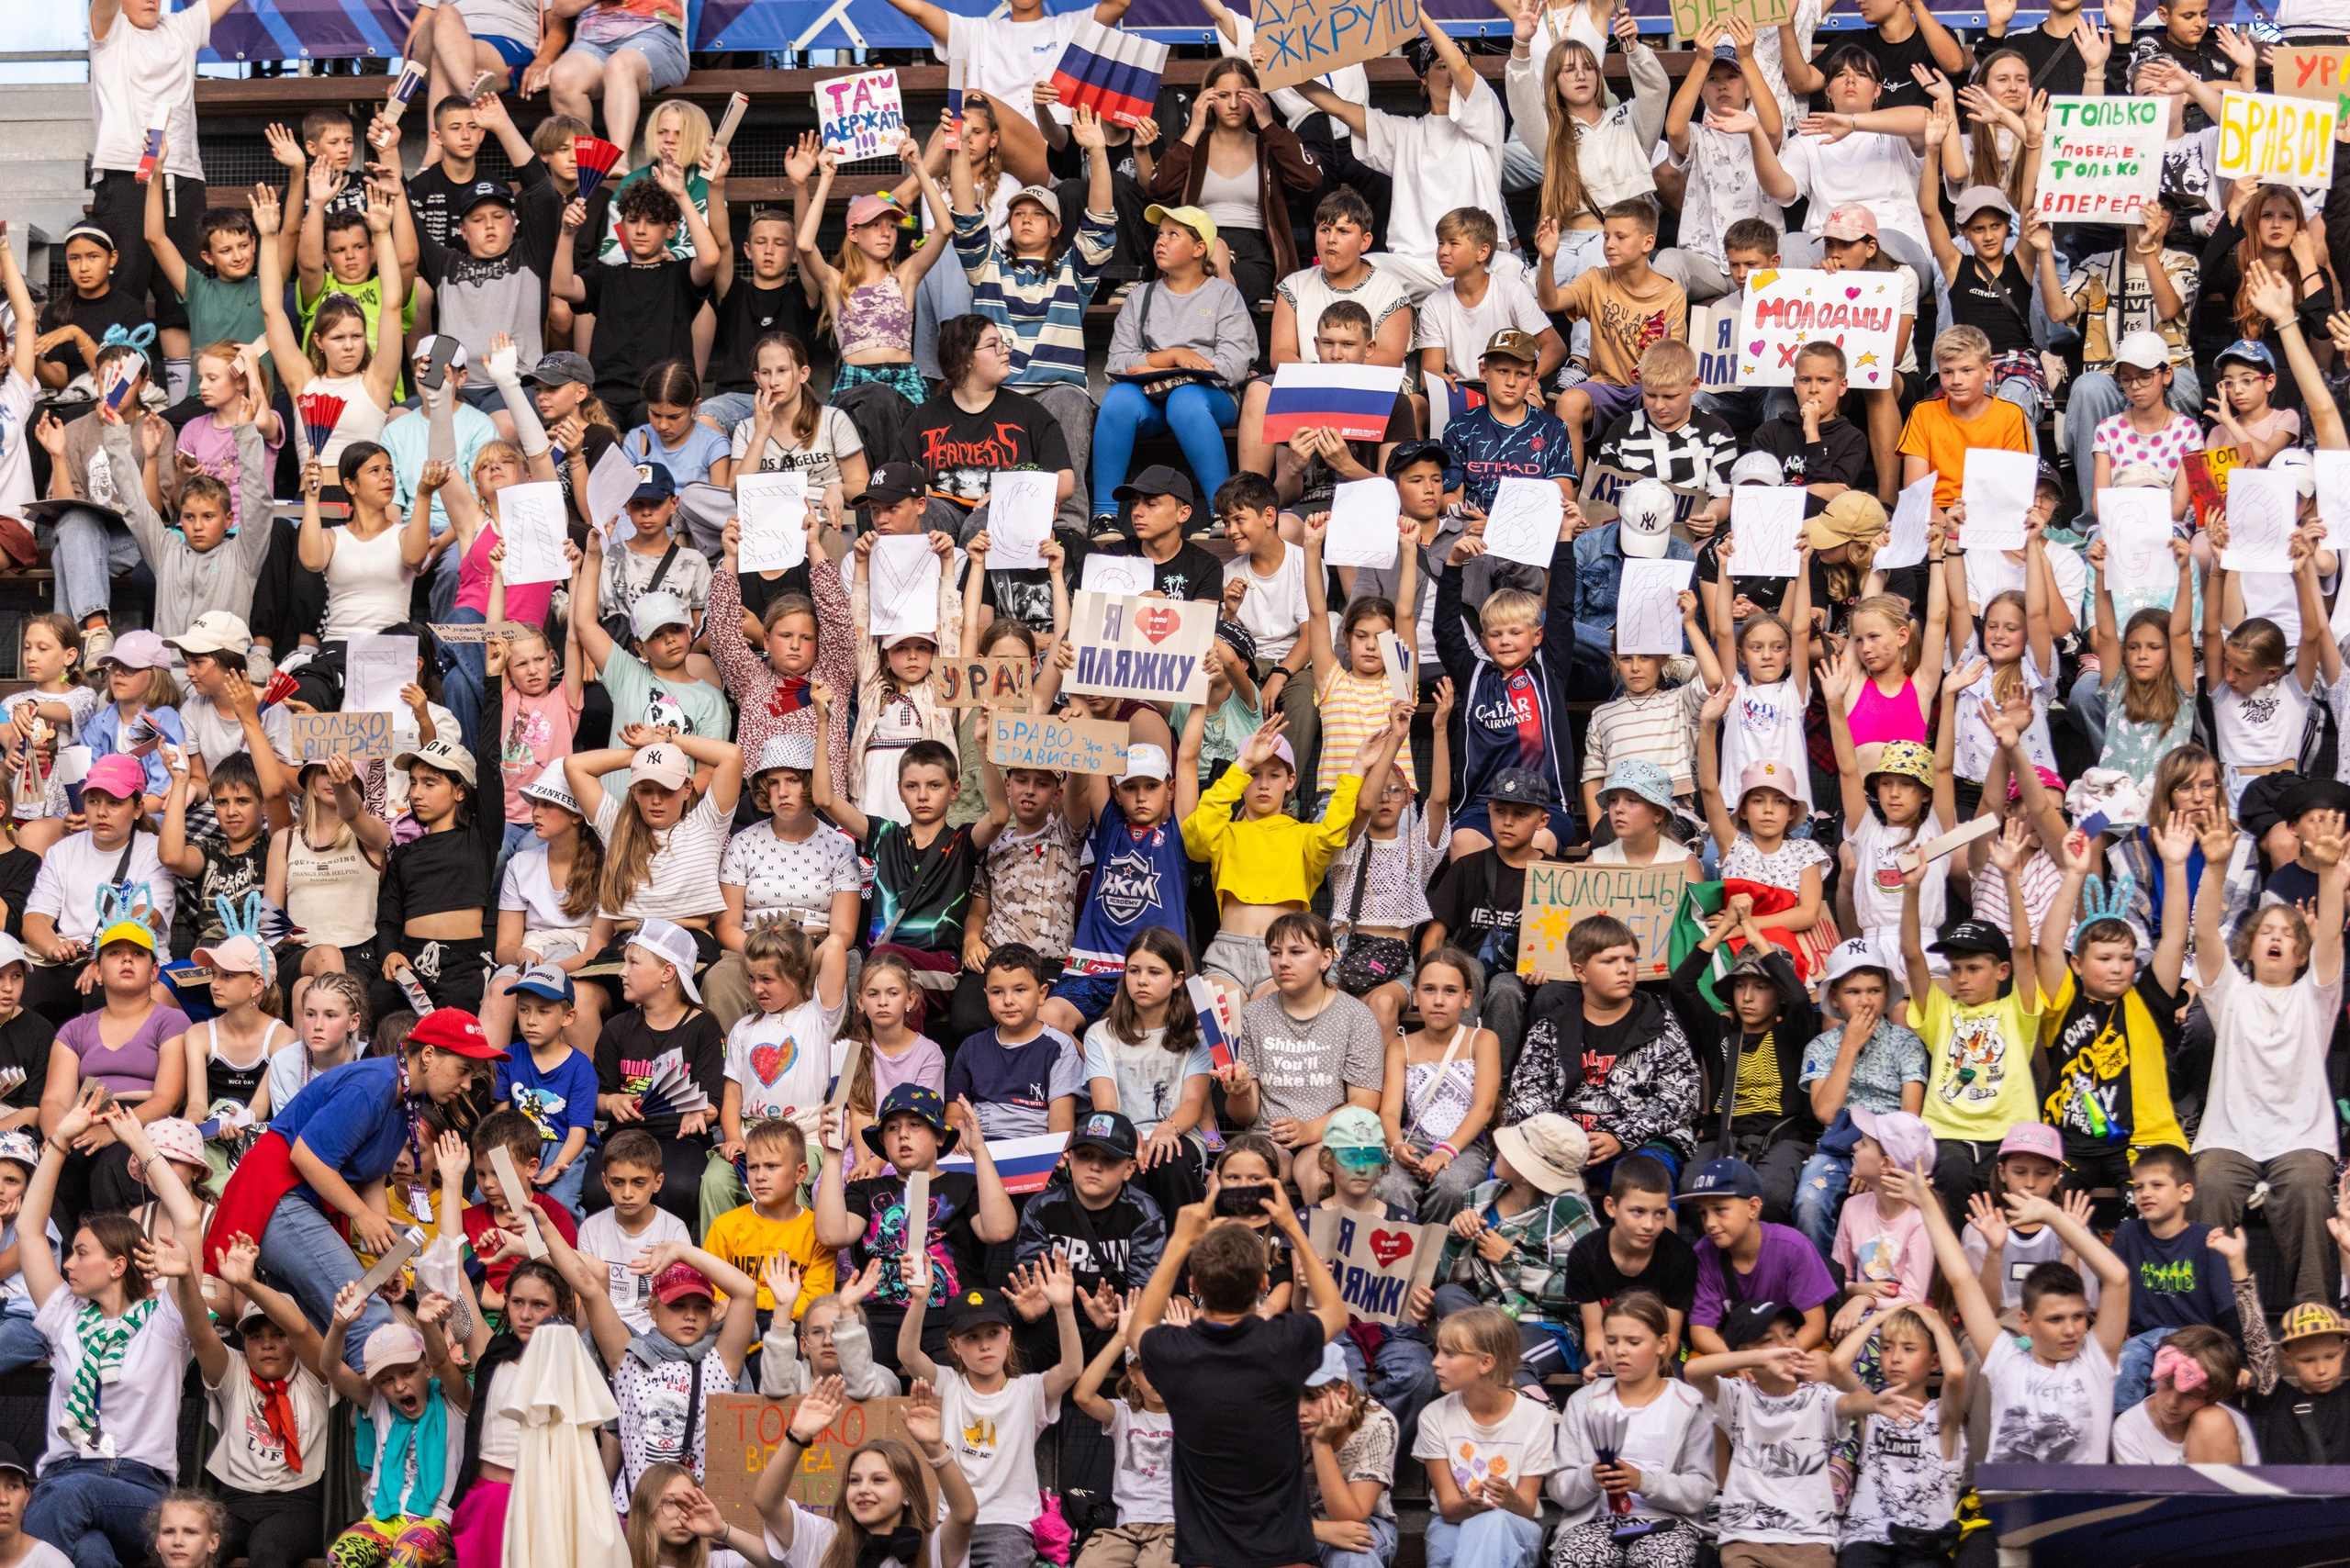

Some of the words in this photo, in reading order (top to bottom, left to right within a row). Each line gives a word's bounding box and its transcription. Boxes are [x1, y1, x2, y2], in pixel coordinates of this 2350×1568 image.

[2053, 102, 2157, 127] ТОЛЬКО
[823, 111, 904, 146] ДЕРЖАТЬ
[2221, 96, 2333, 178] БРАВО!
[2062, 145, 2134, 160] ПОБЕДЕ
[2051, 160, 2140, 180] ТОЛЬКО
[2042, 194, 2144, 215] ВПЕРЁД
[1754, 297, 1892, 332] МОЛОДЦЫ
[1717, 319, 1732, 350] Я
[1698, 352, 1739, 386] ПЛЯ
[759, 458, 775, 470] OS
[780, 453, 829, 470] AGELES
[1467, 461, 1541, 475] ETIHAD
[742, 484, 798, 565] Б
[1639, 511, 1657, 531] NY
[1102, 603, 1124, 643] Я
[1077, 645, 1196, 692] ПЛЯЖКУ
[942, 663, 1024, 702] УРА!
[1475, 697, 1531, 722] QATAR
[1484, 712, 1532, 729] AIRWAYS
[295, 712, 386, 740] ТОЛЬКО
[996, 720, 1074, 748] БРАВО
[304, 735, 393, 759] ВПЕРЕД
[646, 750, 663, 765] NY
[996, 745, 1101, 769] БРАВИСЕМО
[536, 785, 577, 809] YANKEES
[332, 868, 360, 877] HELPING
[1531, 868, 1686, 909] МОЛОДЦЫ
[1848, 940, 1867, 955] NY
[1272, 1056, 1318, 1072] You'll
[1260, 1072, 1305, 1088] Wake
[1309, 1073, 1333, 1087] Me
[1337, 1216, 1356, 1258] Я
[727, 1405, 865, 1447] ТОКО
[248, 1437, 284, 1462] LIF
[1885, 1439, 1919, 1454] LIMIT
